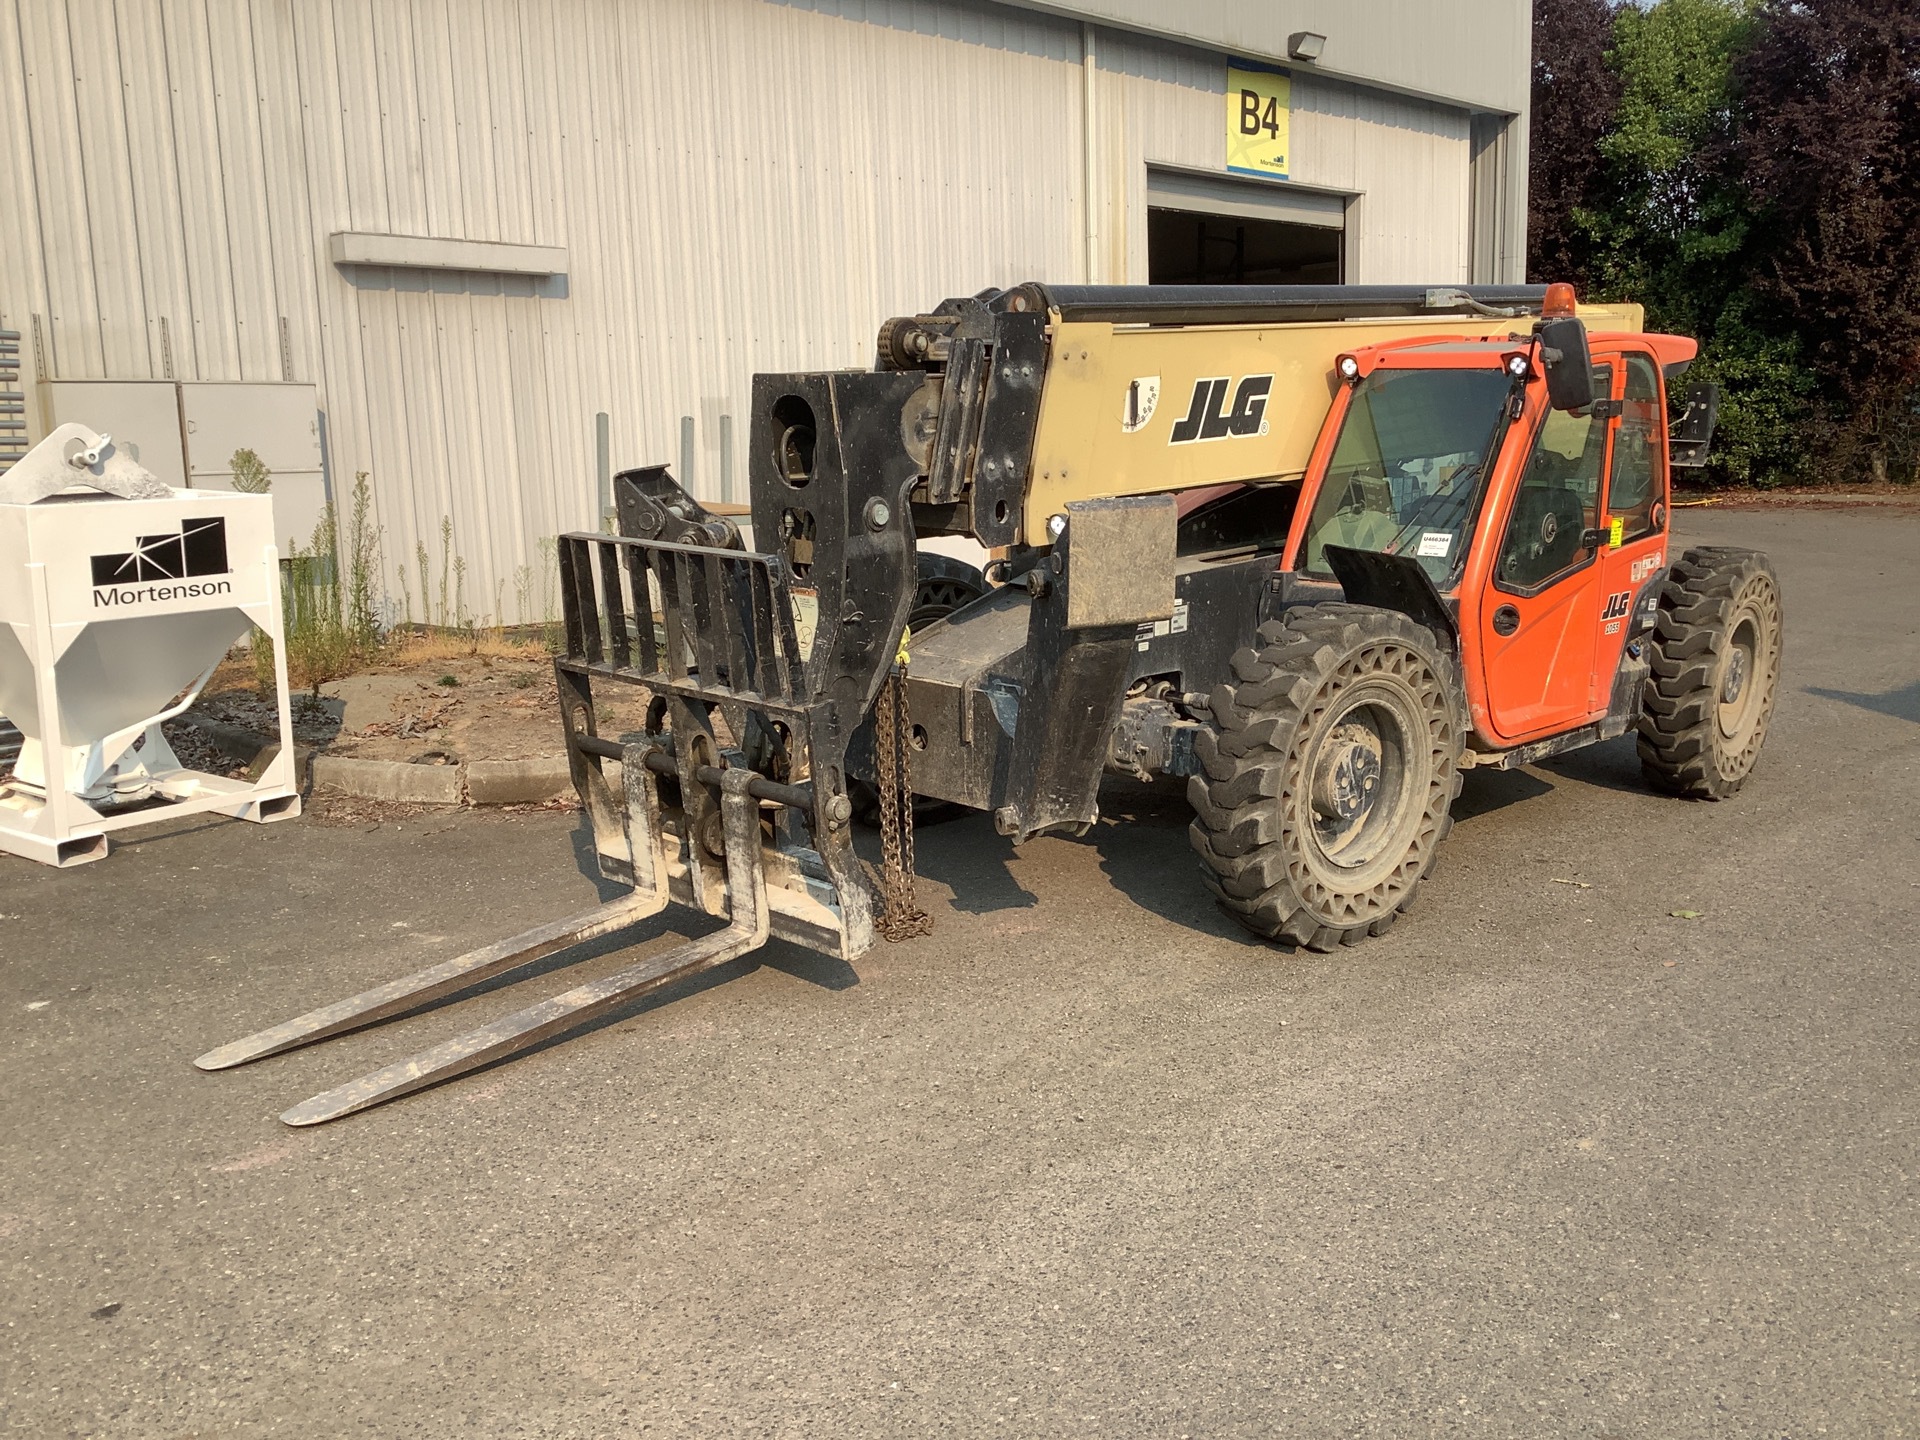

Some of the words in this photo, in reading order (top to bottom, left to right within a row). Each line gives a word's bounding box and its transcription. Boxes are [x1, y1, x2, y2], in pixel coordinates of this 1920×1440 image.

[1240, 88, 1280, 140] B4
[1260, 158, 1285, 168] Mortenson
[1169, 374, 1273, 443] JLG
[92, 580, 232, 607] Mortenson
[1601, 591, 1631, 620] JLG
[1605, 622, 1620, 634] 1055
